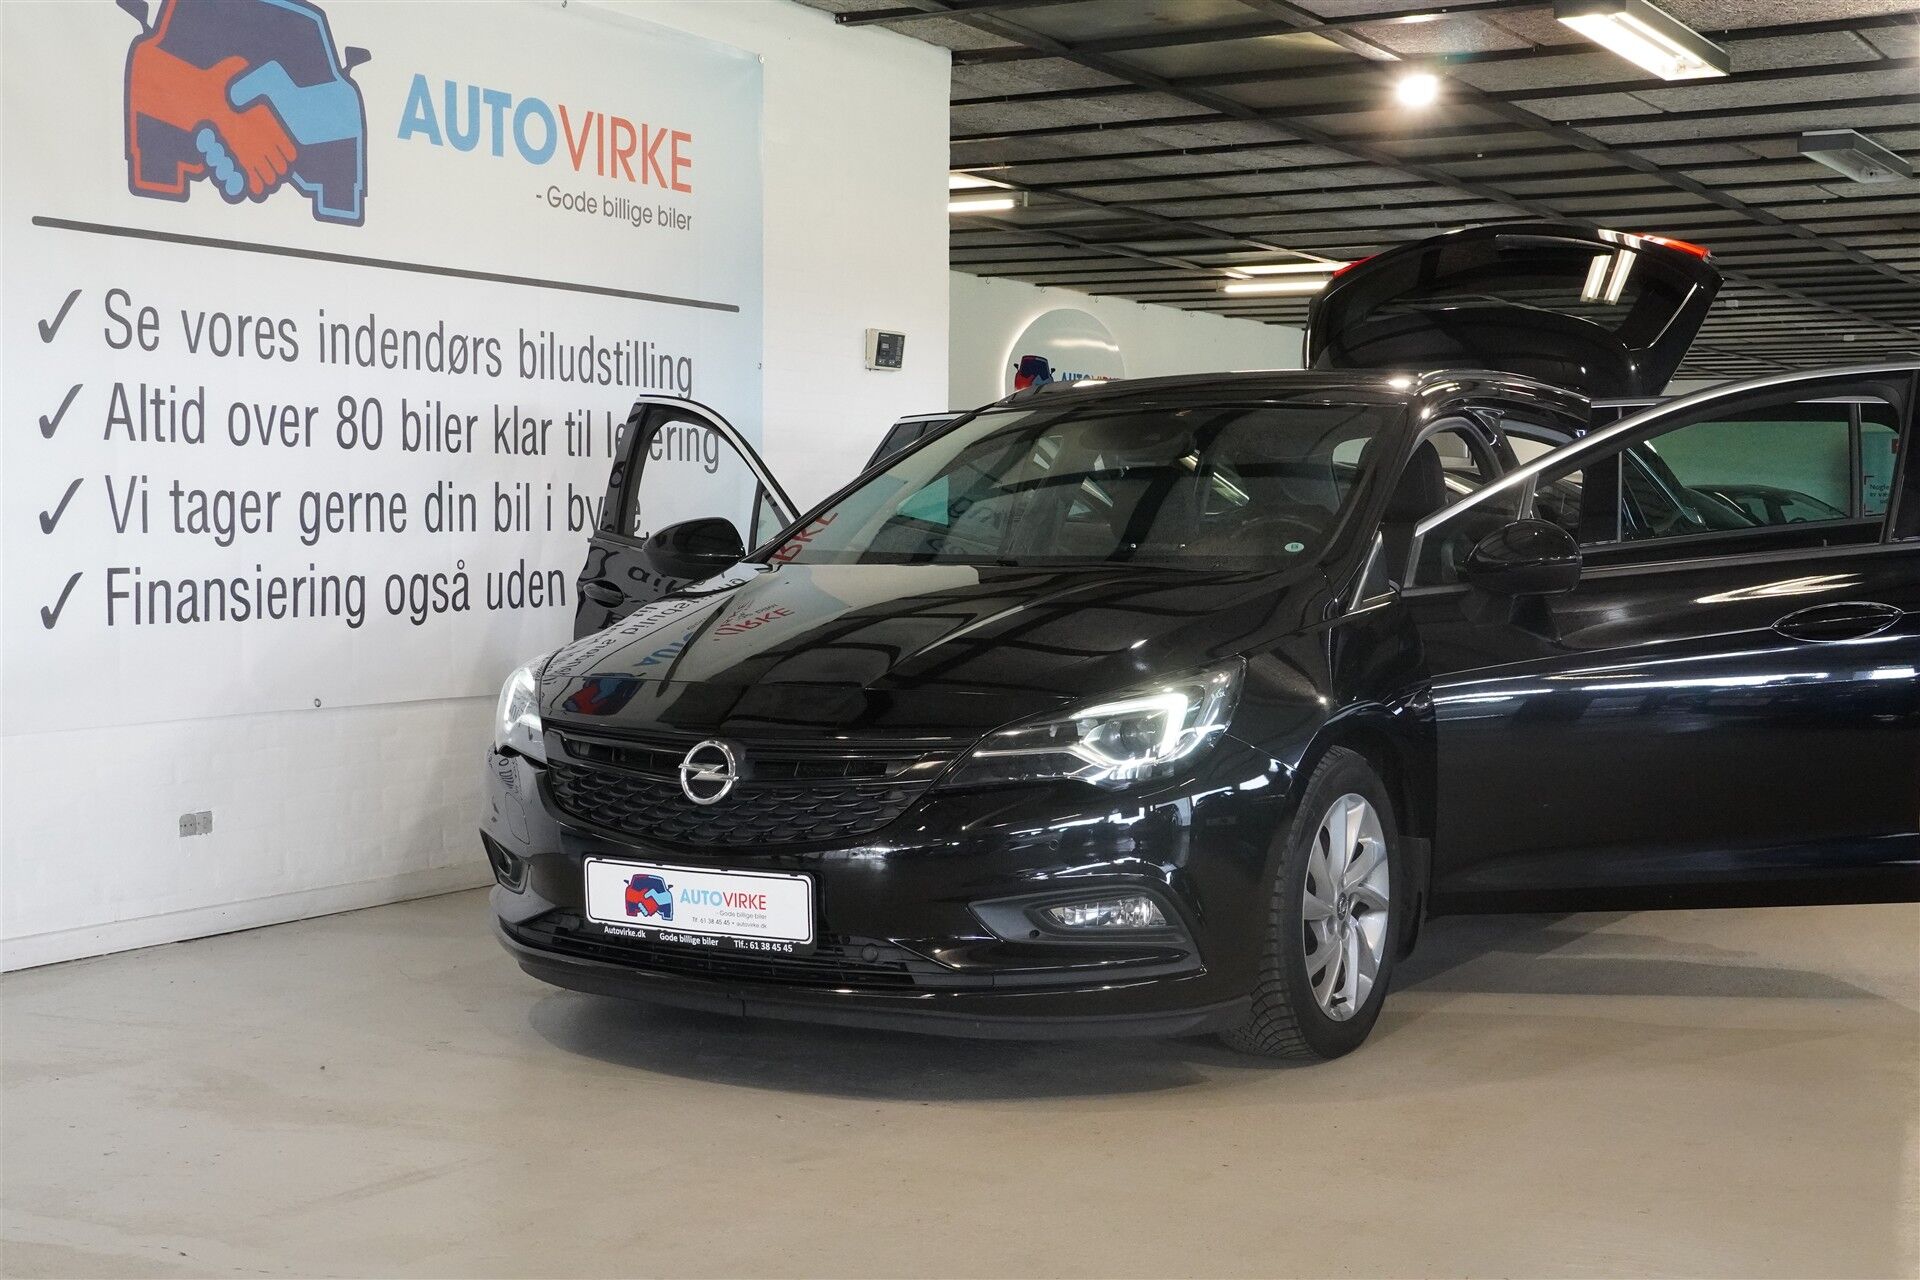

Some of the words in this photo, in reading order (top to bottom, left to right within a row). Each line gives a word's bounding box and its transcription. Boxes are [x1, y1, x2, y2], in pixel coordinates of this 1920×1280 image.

[398, 73, 692, 193] AUTOVIRKE
[547, 185, 597, 214] Gode
[603, 195, 653, 227] billige
[658, 207, 692, 231] biler
[104, 288, 160, 352] Se
[180, 310, 300, 363] vores
[319, 308, 502, 379] indendørs
[519, 328, 693, 400] biludstilling
[103, 382, 205, 445] Altid
[228, 402, 319, 447] over
[336, 395, 383, 451] 80
[401, 398, 478, 454] biler
[494, 404, 552, 456] klar
[565, 409, 591, 458] til
[606, 411, 720, 474] leering
[104, 475, 148, 534] Vi
[169, 479, 281, 547] tager
[300, 491, 407, 546] gerne
[424, 480, 477, 532] din
[494, 481, 530, 532] bil
[547, 482, 552, 532] i
[106, 563, 366, 629] Finansiering
[385, 559, 471, 625] også
[487, 558, 566, 610] uden
[680, 888, 767, 910] AUTOVIRKE
[604, 926, 646, 938] Autovirke.dk
[660, 932, 678, 942] Gode
[679, 935, 701, 946] billige
[702, 937, 719, 946] biler
[749, 941, 759, 950] 61
[761, 942, 770, 951] 38
[772, 943, 781, 952] 45
[783, 944, 793, 953] 45
